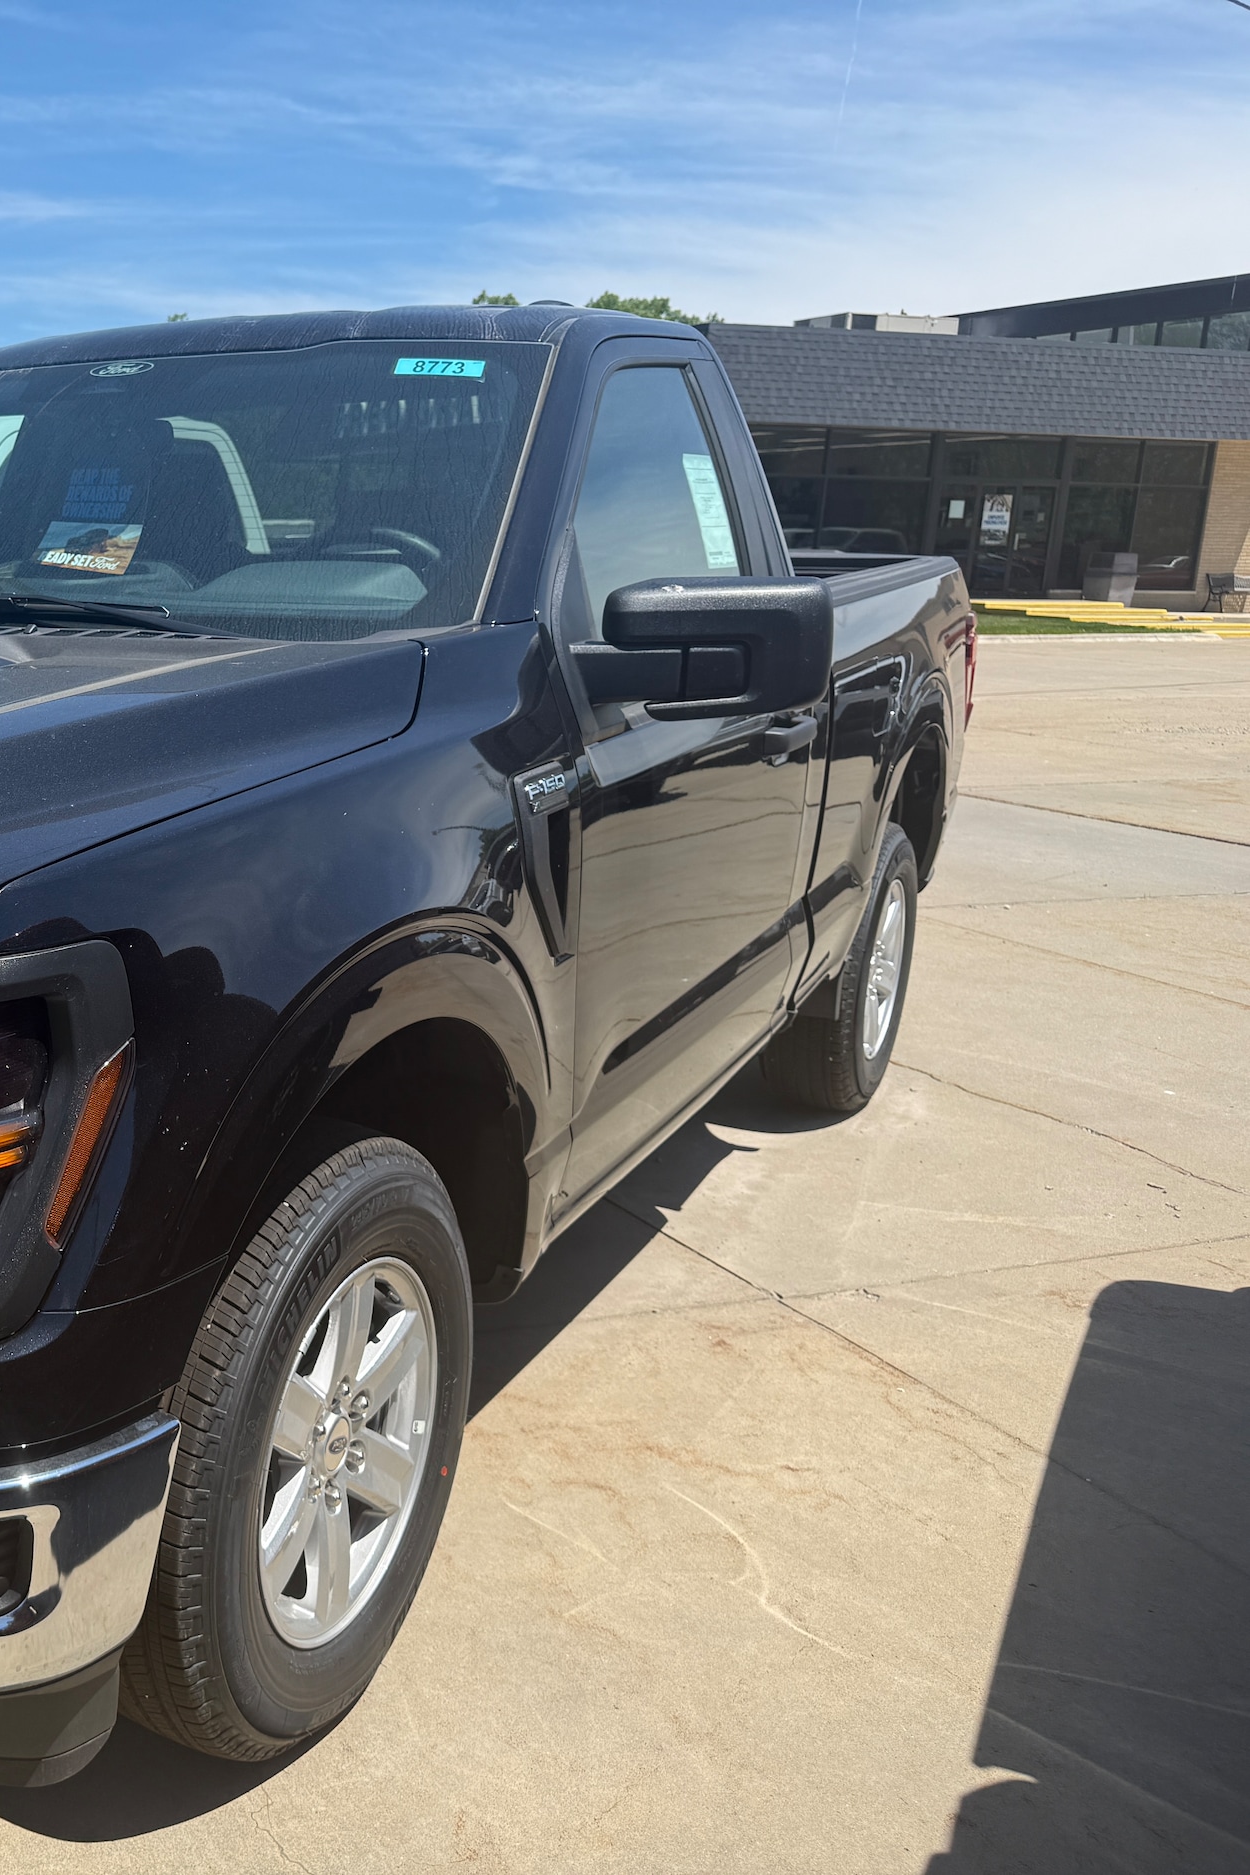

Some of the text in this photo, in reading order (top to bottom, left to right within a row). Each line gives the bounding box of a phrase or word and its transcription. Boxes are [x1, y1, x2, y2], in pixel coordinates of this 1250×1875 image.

[99, 362, 144, 375] Ford
[412, 360, 465, 374] 8773
[118, 484, 134, 502] OF
[62, 502, 127, 519] OWNERSHIP
[71, 553, 95, 568] SET
[88, 556, 120, 571] Ford
[524, 773, 566, 800] F-150
[257, 1236, 339, 1402] MICHELIN
